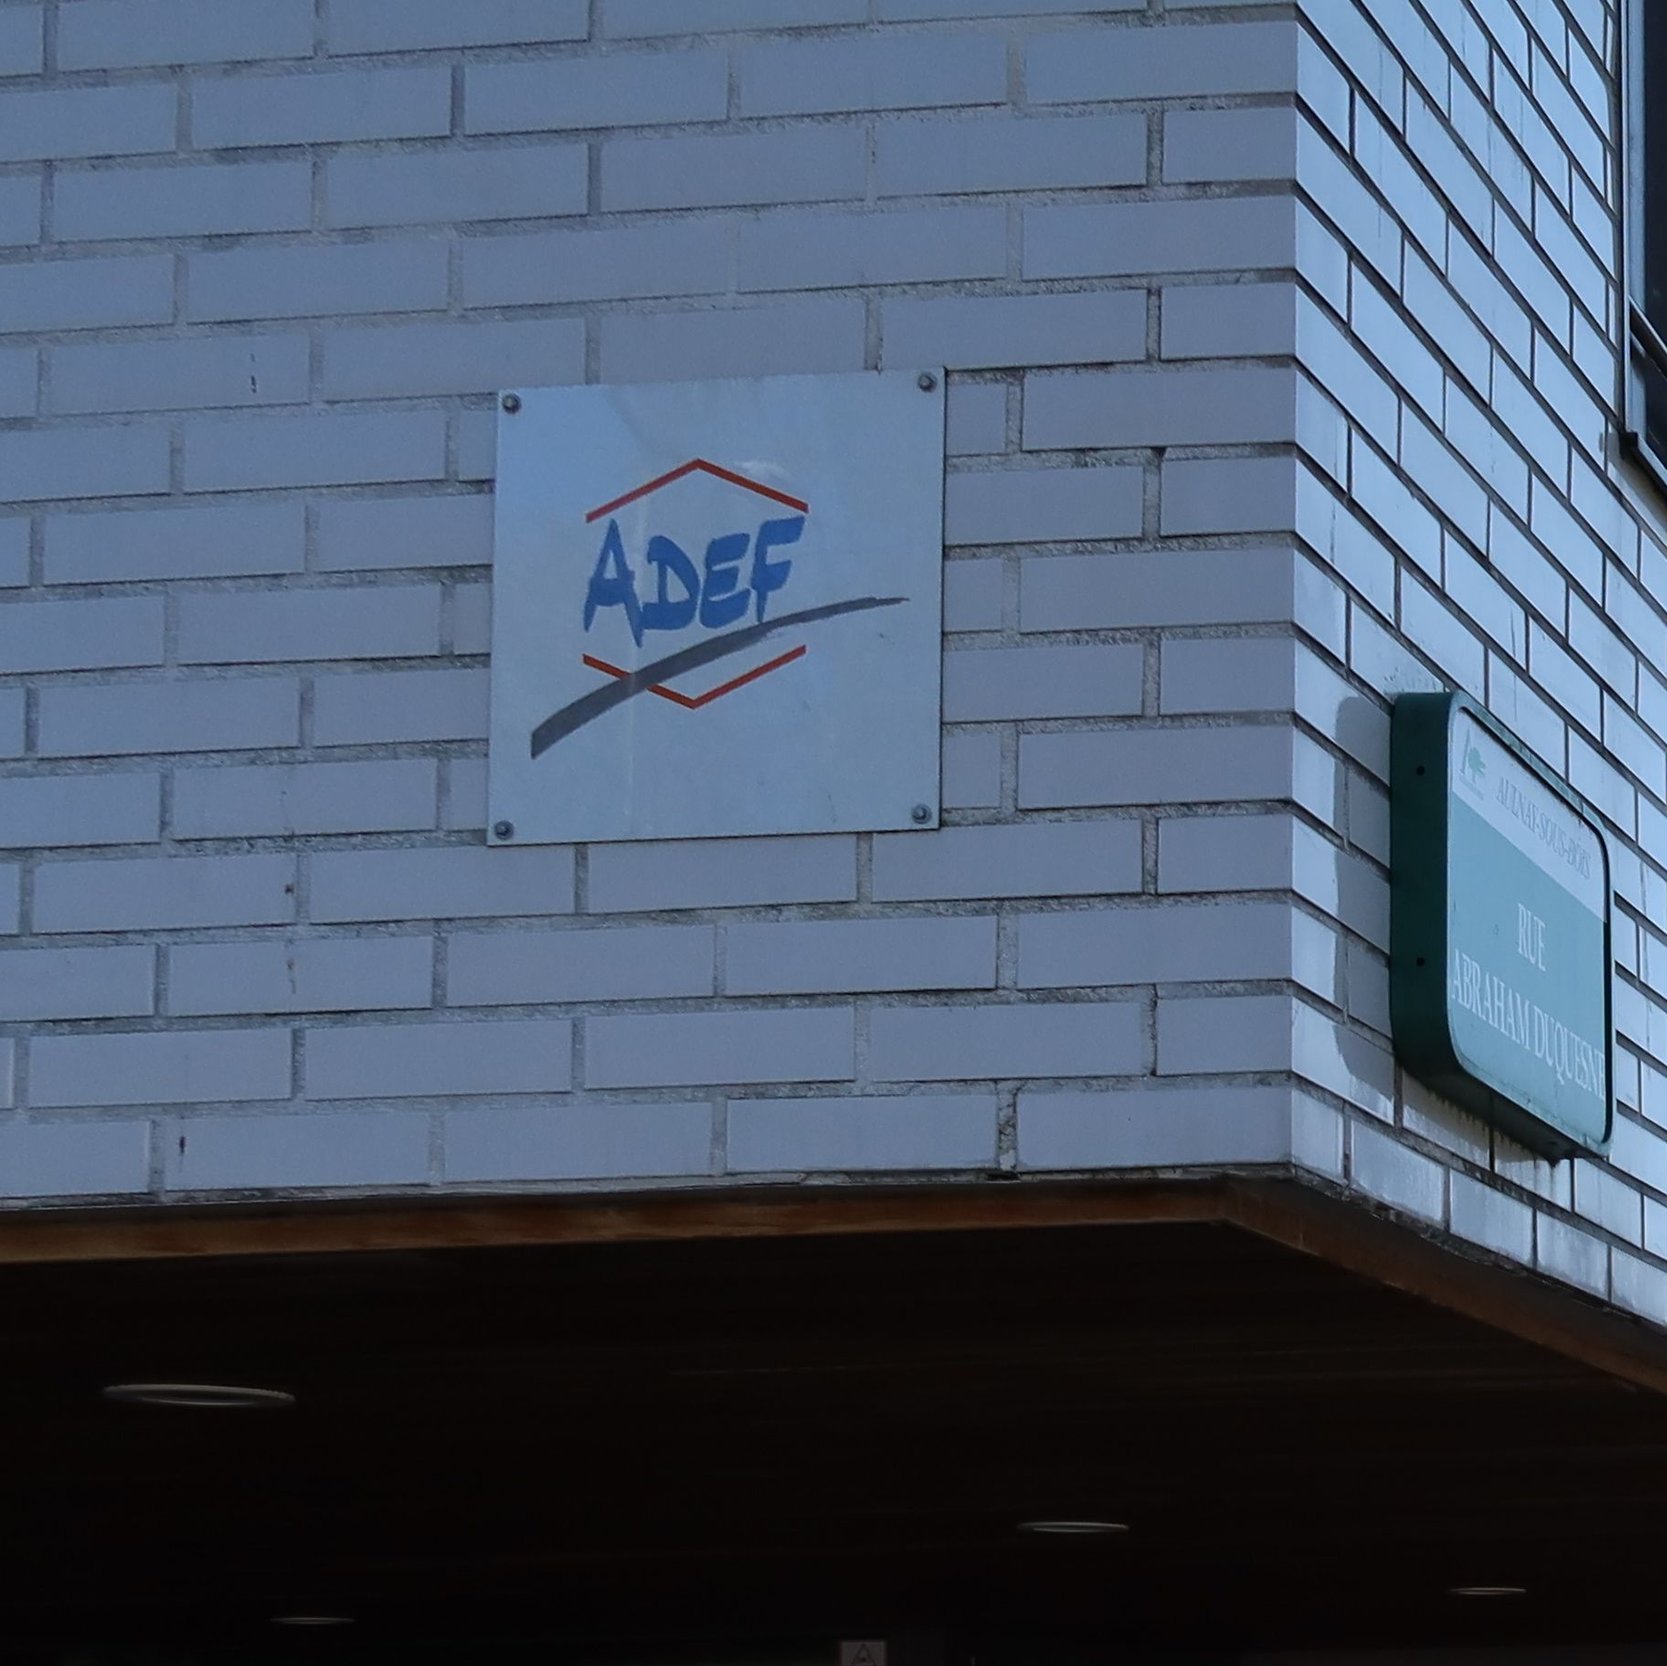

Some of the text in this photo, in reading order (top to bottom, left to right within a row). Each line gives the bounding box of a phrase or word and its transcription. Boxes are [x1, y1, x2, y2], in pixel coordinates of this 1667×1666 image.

[582, 515, 806, 648] ADEF
[1518, 903, 1546, 972] RUE
[1452, 949, 1606, 1099] ABRAHAM DUQUESNE
